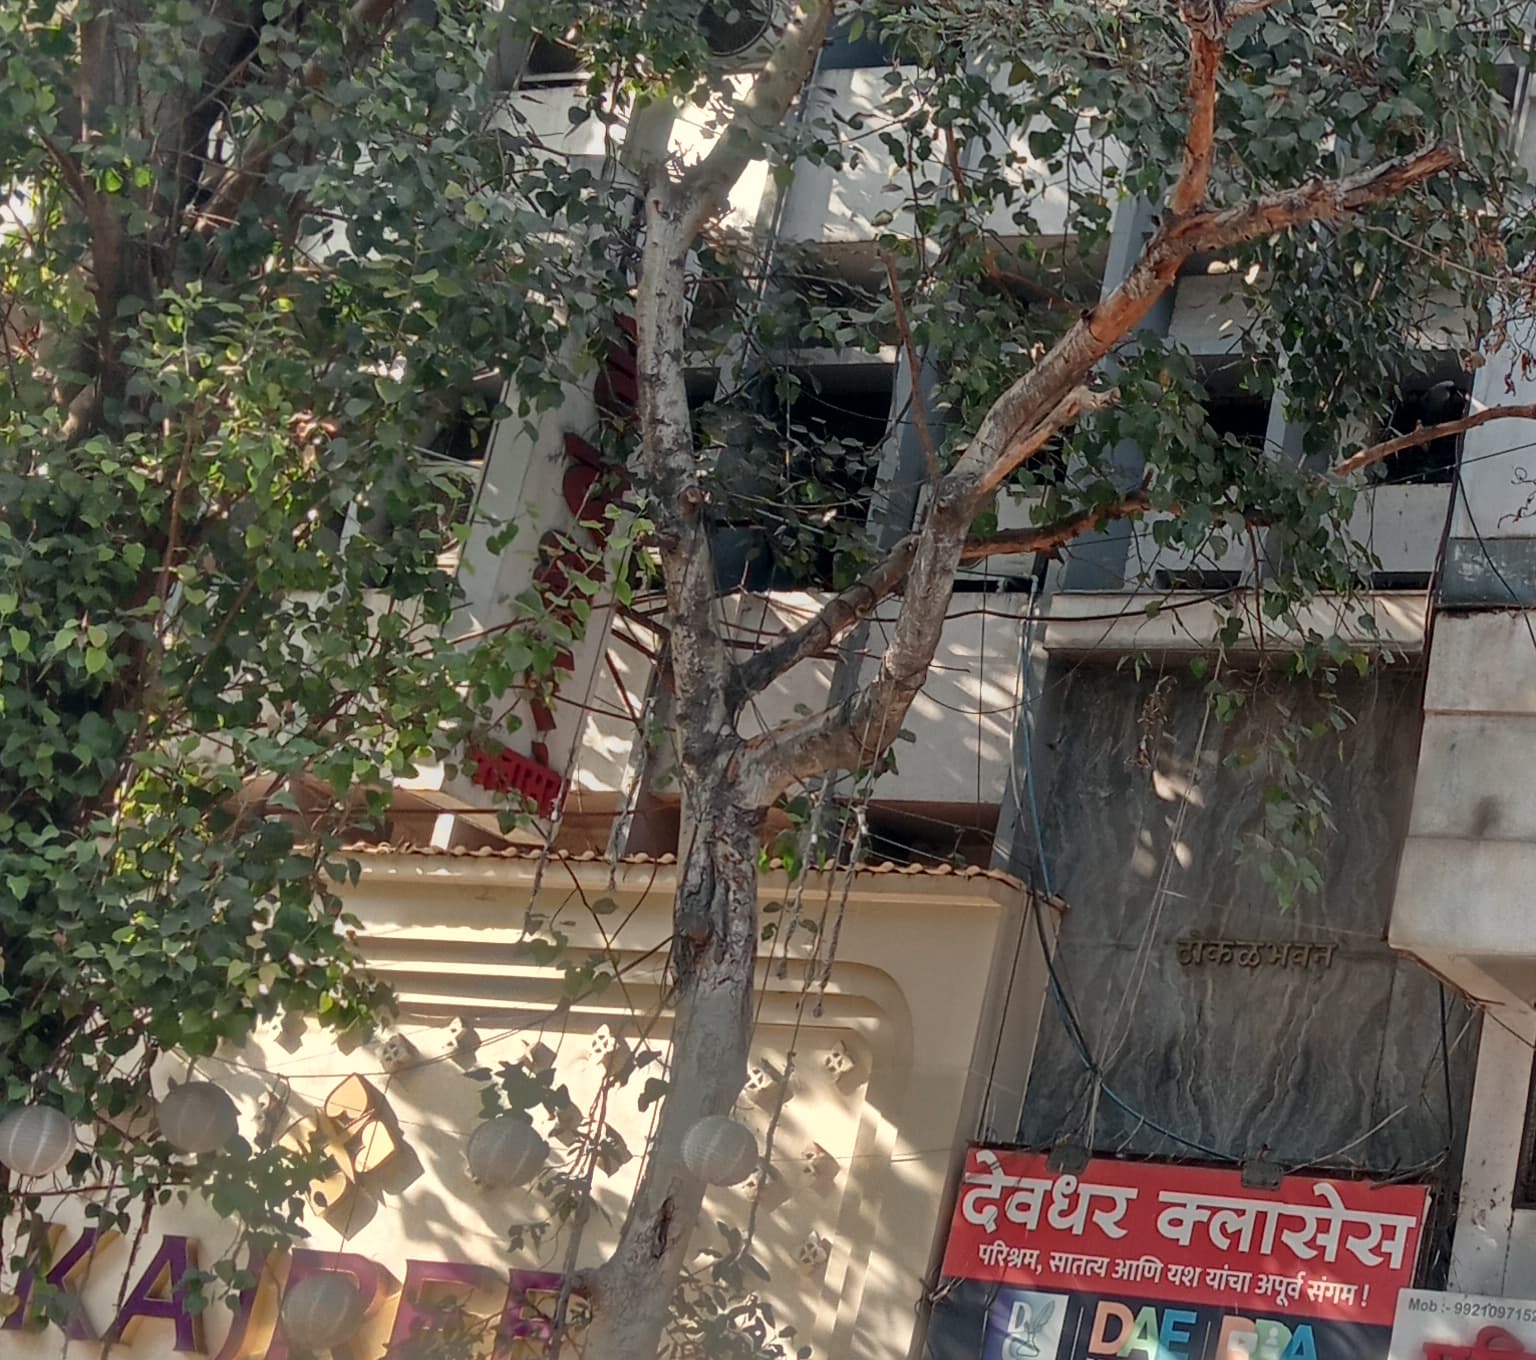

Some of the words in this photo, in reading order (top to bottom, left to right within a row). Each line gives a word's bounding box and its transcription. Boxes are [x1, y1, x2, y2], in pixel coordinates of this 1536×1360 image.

[962, 1150, 1138, 1239] देवधर
[1157, 1182, 1417, 1270] क्लासेस
[979, 1240, 1043, 1275] परिश्रम,
[1050, 1251, 1109, 1278] सातत्य
[1112, 1255, 1163, 1283] आणि
[1167, 1264, 1201, 1288] यश
[1206, 1264, 1252, 1293] यांचा
[1255, 1271, 1306, 1307] अपूर्व
[1308, 1275, 1358, 1305] संगम
